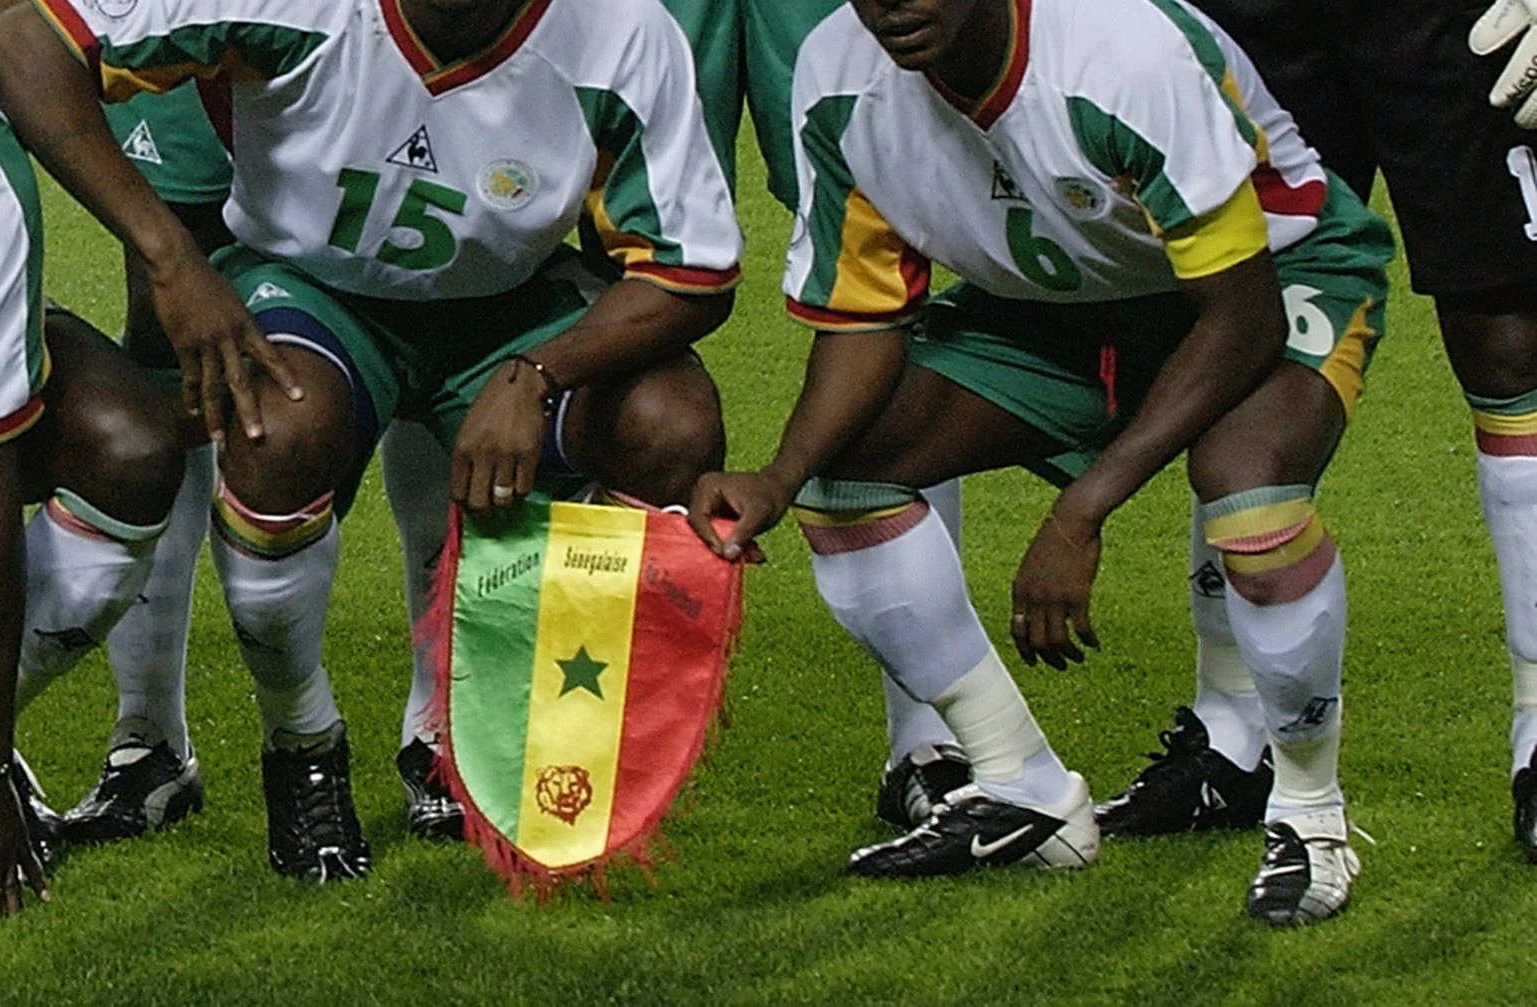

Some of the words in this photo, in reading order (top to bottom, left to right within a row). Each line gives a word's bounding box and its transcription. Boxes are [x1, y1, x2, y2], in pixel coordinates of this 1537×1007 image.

[327, 166, 468, 272] 15
[1005, 207, 1084, 292] 6
[1282, 283, 1335, 357] 6
